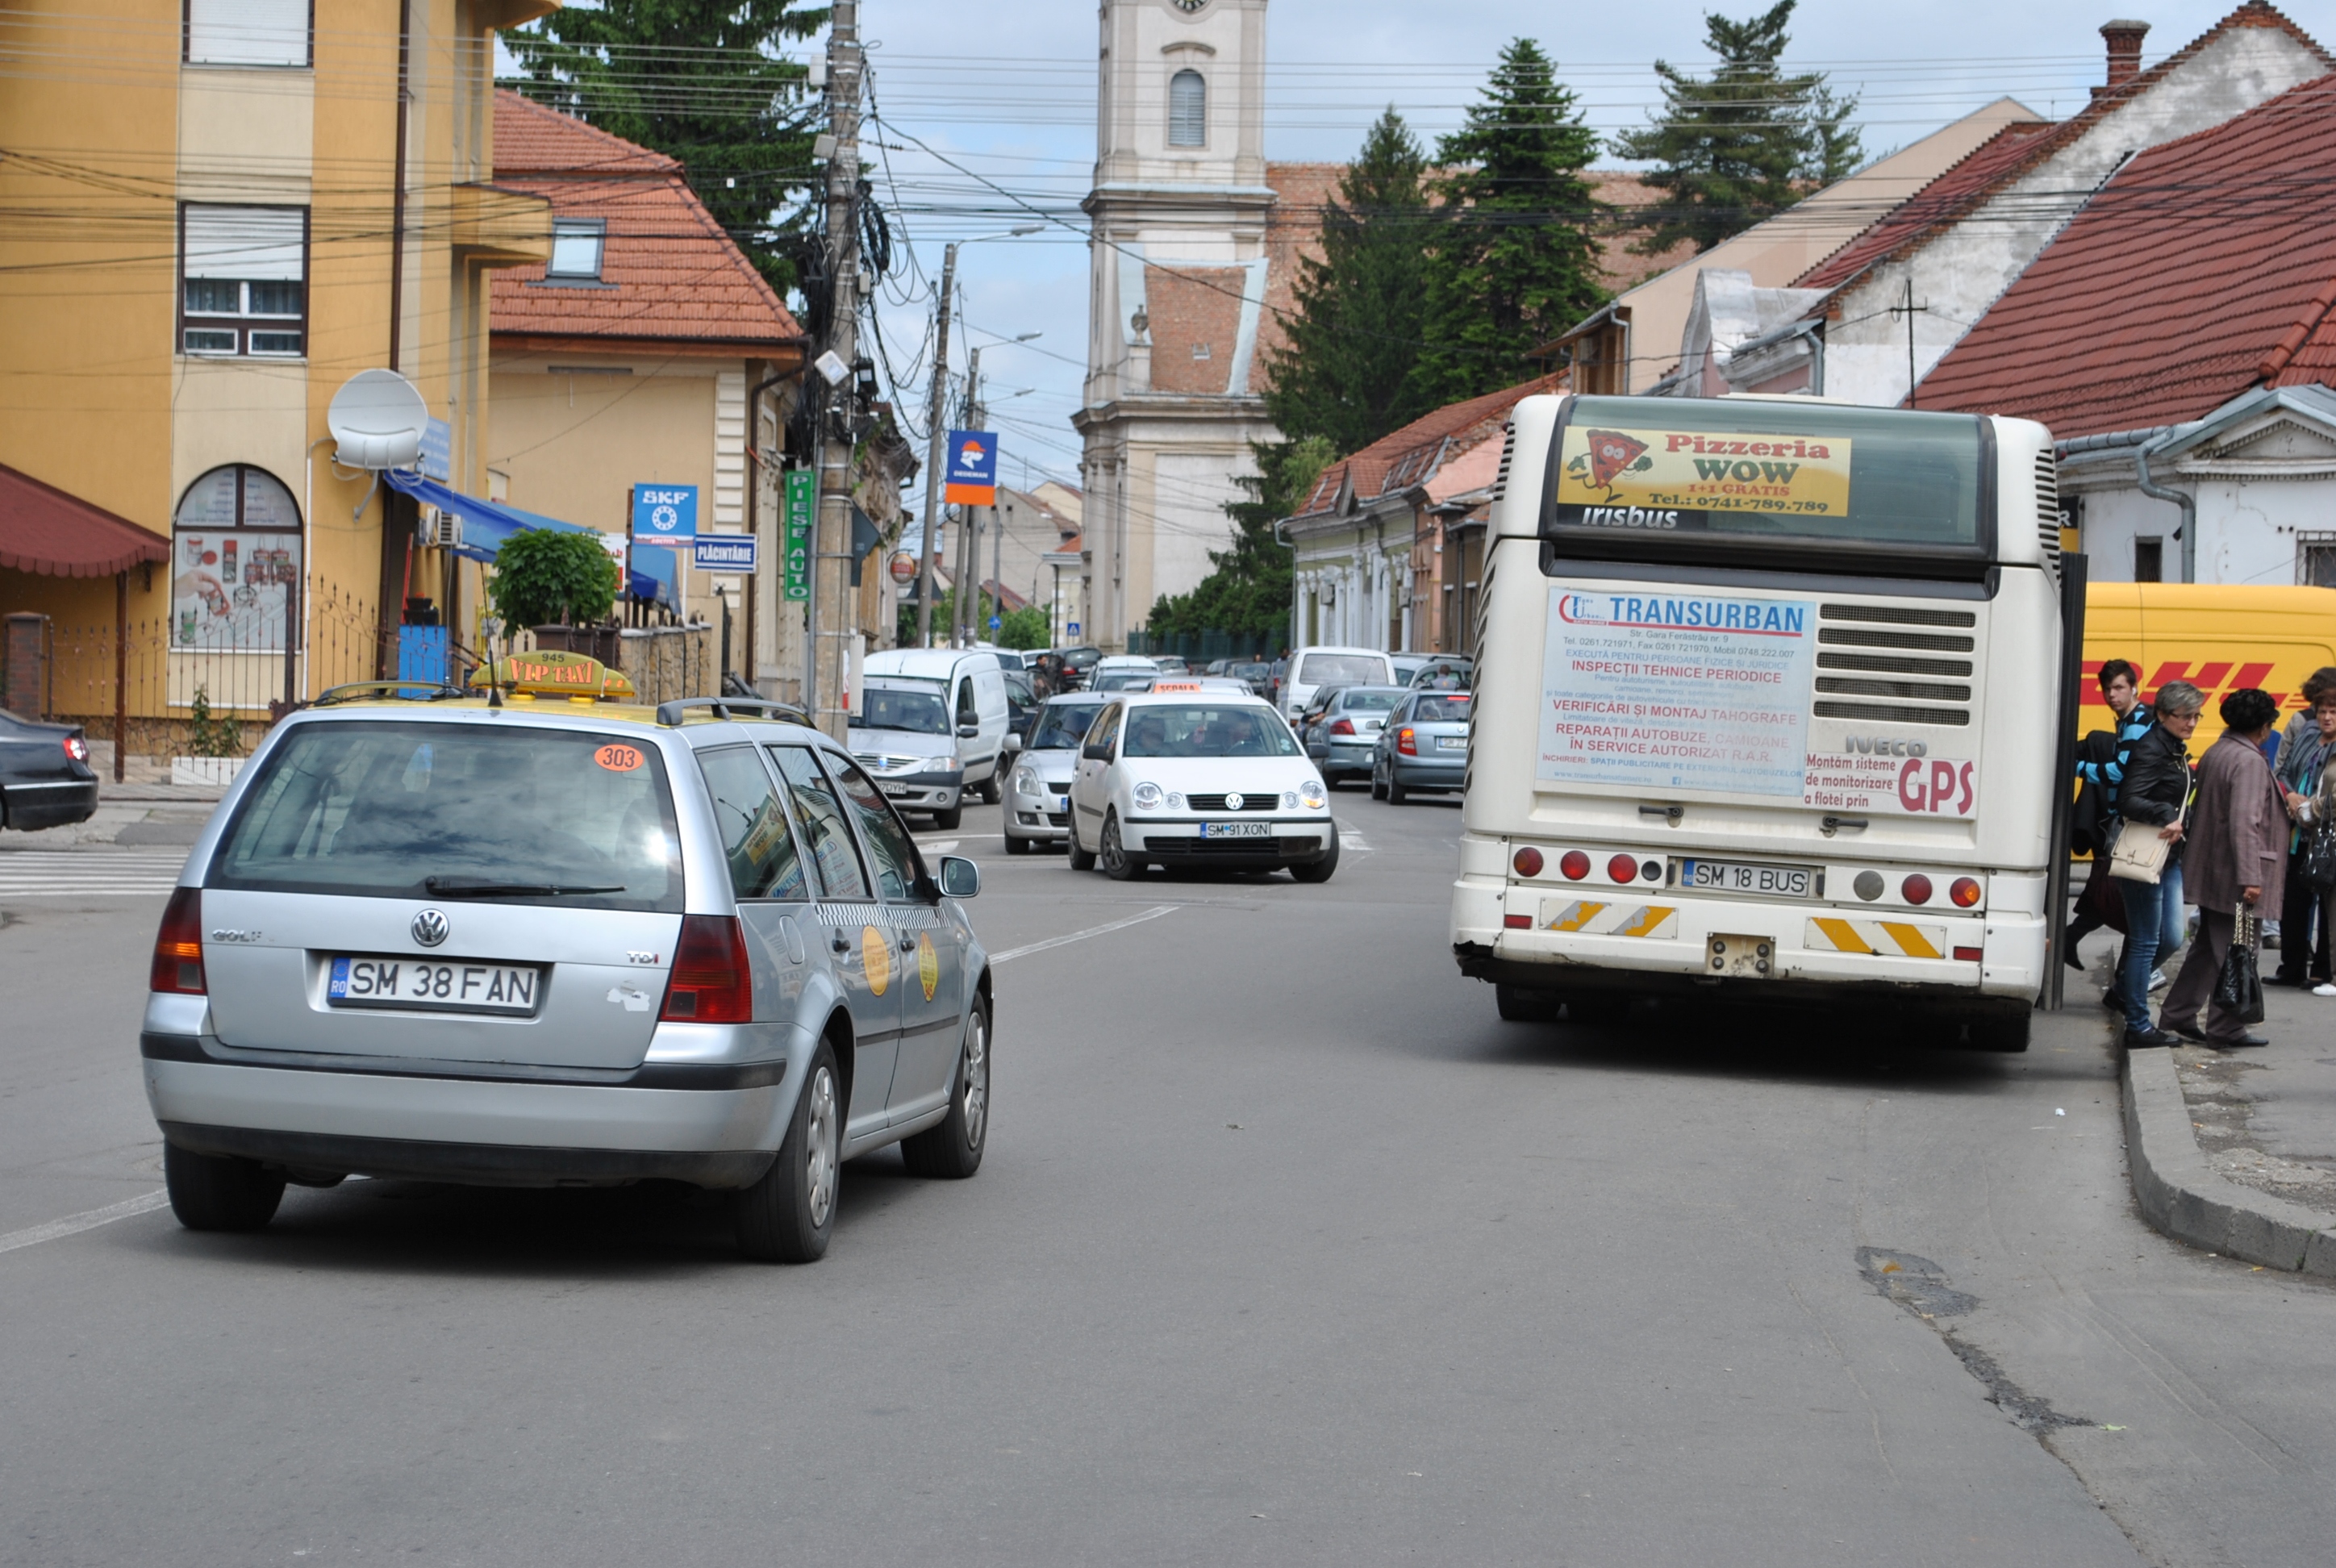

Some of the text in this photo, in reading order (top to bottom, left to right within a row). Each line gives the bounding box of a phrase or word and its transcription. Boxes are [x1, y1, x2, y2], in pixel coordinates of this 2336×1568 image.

[1665, 434, 1831, 460] Pizzeria
[953, 469, 988, 479] DEDEMAN
[1693, 458, 1800, 485] WOW
[643, 490, 689, 505] SKF
[1687, 483, 1791, 497] 1+1 GRATIS
[1696, 496, 1829, 513] 0741-789.789
[789, 476, 808, 598] PIESE AUTO
[1609, 596, 1804, 632] TRANSURBAN
[1563, 636, 1578, 645] Tel.
[1638, 640, 1653, 650] Fax
[1655, 642, 1676, 652] 0261
[1713, 645, 1736, 655] Mobil
[1629, 629, 1643, 638] Str.
[1646, 630, 1666, 640] Gara
[1710, 635, 1721, 643] nr.
[542, 653, 565, 663] 945
[1612, 652, 1649, 662] PENTRU
[1651, 654, 1702, 665] PERSOANE
[1704, 657, 1734, 667] FIZICE
[1747, 659, 1790, 671] JURIDICE
[510, 657, 549, 682] VIP
[553, 661, 594, 683] TAXI
[1595, 673, 1620, 683] Pentru
[1642, 664, 1703, 680] TEHNICE
[1706, 668, 1782, 684] PERIODICE
[2079, 661, 2289, 707] DHL
[1554, 690, 1575, 699] toate
[1618, 694, 1625, 702] de
[1553, 699, 1629, 715] VERIFICĂRI
[1650, 706, 1707, 720] MONTAJ
[1711, 710, 1797, 725] TAHOGRAFE
[1631, 728, 1711, 744] AUTOBUZE,
[1715, 734, 1790, 749] CAMIOANE
[1846, 735, 1928, 757] IVECO
[603, 748, 636, 768] 303
[1570, 736, 1773, 762] ÎN SERVICE AUTORIZAT R.A.R.
[1618, 758, 1671, 769] PUBLICITARE
[1673, 762, 1685, 770] PE
[1741, 767, 1803, 778] AUTOBUZELOR
[1807, 754, 1896, 771] Montăm sisteme
[1805, 773, 1894, 790] de monitorizare
[1899, 758, 1975, 815] GPS
[1804, 791, 1870, 809] a flotei prin
[1208, 824, 1224, 836] SM
[1229, 824, 1240, 836] 91
[1243, 824, 1267, 836] XON
[1683, 865, 1807, 892] RO SM 18 BUS
[627, 951, 659, 965] TDI
[332, 962, 533, 1005] RO SM 38 FAN
